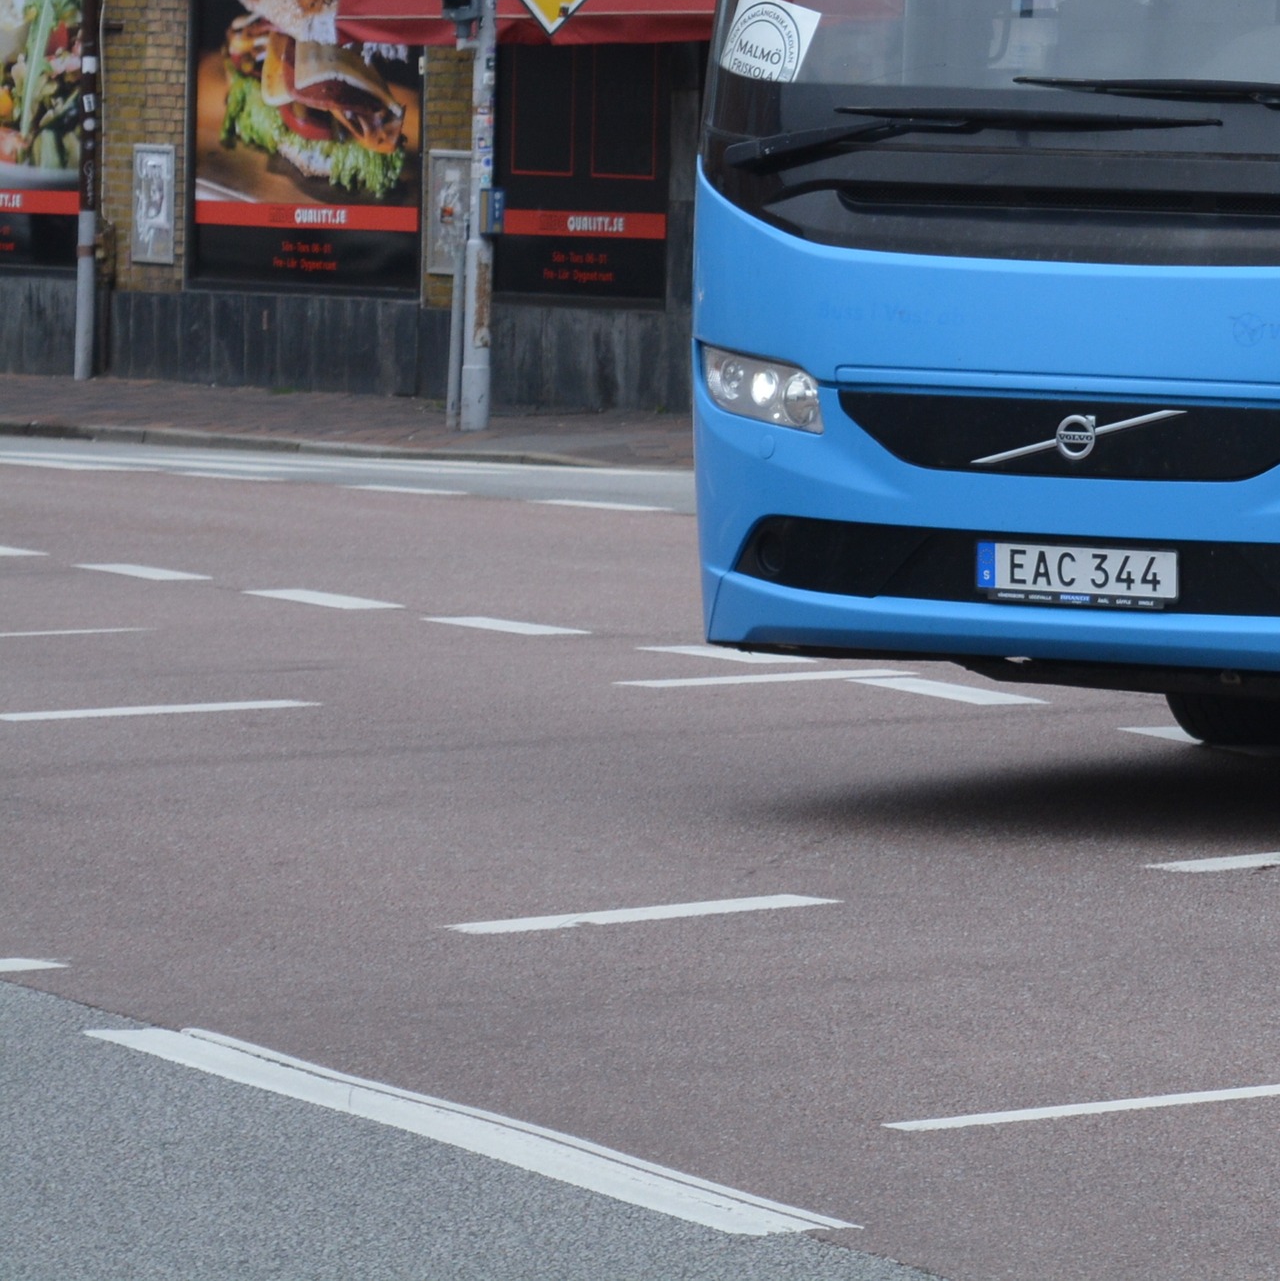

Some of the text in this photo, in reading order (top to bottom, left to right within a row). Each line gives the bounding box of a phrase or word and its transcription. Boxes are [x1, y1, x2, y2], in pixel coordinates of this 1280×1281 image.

[736, 38, 782, 66] MALMÖ
[785, 30, 795, 63] SKOLAN
[1059, 433, 1093, 441] VOLVO
[983, 570, 991, 580] S
[1009, 548, 1161, 592] EAC 344
